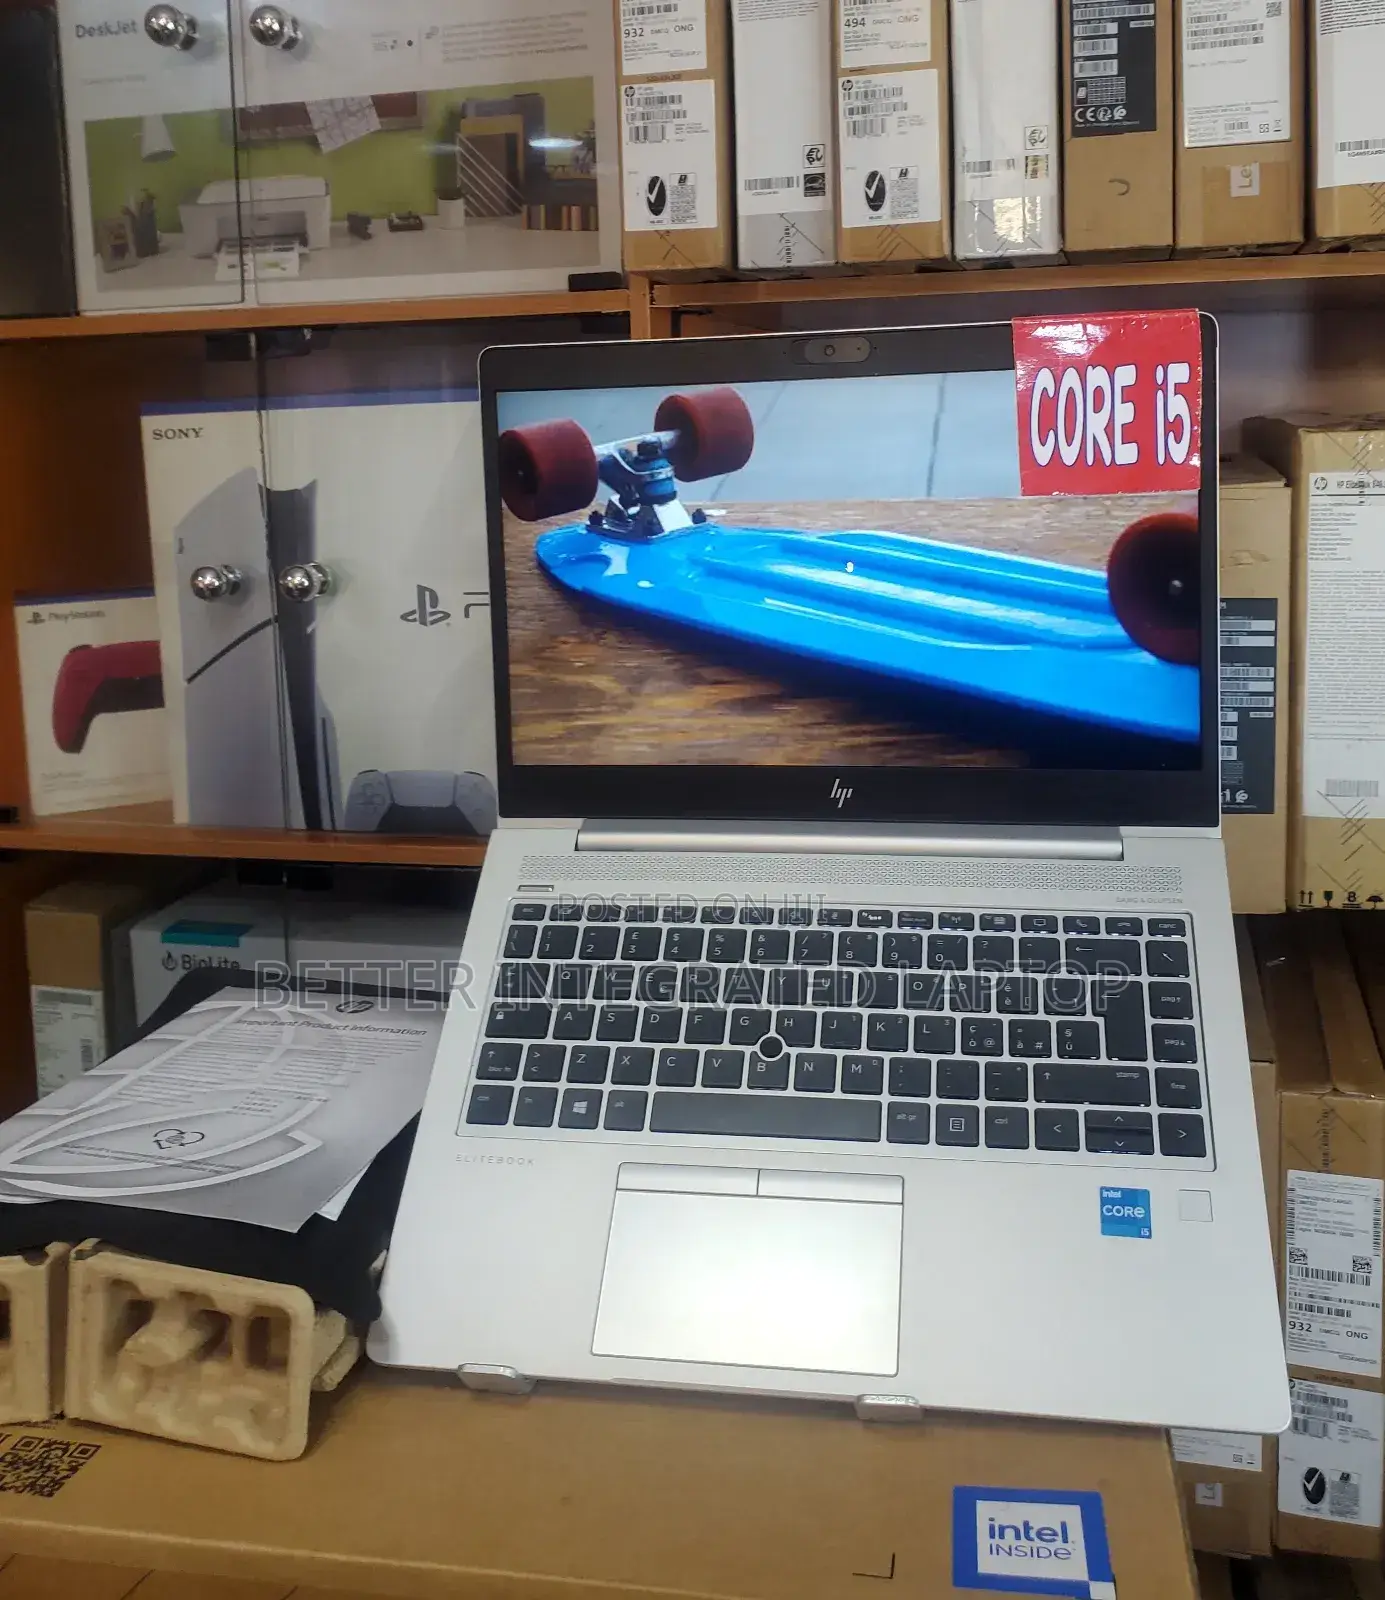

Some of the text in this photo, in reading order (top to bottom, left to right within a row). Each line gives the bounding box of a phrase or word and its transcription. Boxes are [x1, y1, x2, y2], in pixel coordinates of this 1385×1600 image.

[844, 17, 866, 28] 494
[76, 20, 138, 38] DeskJet
[623, 27, 645, 38] 932
[673, 23, 694, 33] ONG
[1030, 361, 1191, 468] CORE i5
[152, 427, 203, 440] SONY
[829, 778, 854, 808] hp
[586, 944, 595, 953] 2
[628, 945, 637, 953] 3
[671, 946, 679, 954] 4
[713, 947, 722, 956] 5
[757, 947, 765, 956] 6
[800, 949, 809, 957] 7
[845, 950, 854, 959] 8
[890, 951, 898, 960] 9
[561, 970, 572, 980] Q
[604, 971, 617, 981] W
[645, 972, 655, 982] E
[689, 974, 699, 983] R
[778, 975, 787, 986] Y
[563, 1011, 573, 1021] A
[606, 1012, 616, 1023] S
[650, 1013, 660, 1023] D
[694, 1014, 704, 1025] F
[739, 1016, 750, 1026] G
[235, 1018, 428, 1036] Important Product Information
[784, 1017, 794, 1027] H
[828, 1019, 838, 1029] J
[876, 1021, 886, 1032] K
[922, 1023, 931, 1034] L
[576, 1053, 587, 1064] Z
[620, 1055, 632, 1066] X
[666, 1056, 676, 1067] C
[711, 1058, 722, 1068] V
[756, 1062, 766, 1072] B
[803, 1062, 814, 1072] N
[851, 1063, 863, 1074] M
[455, 1154, 535, 1166] ELITEBOOK
[1102, 1190, 1122, 1198] intel
[1288, 1320, 1313, 1333] 932
[1345, 1330, 1369, 1340] ONG
[988, 1517, 1069, 1544] intel
